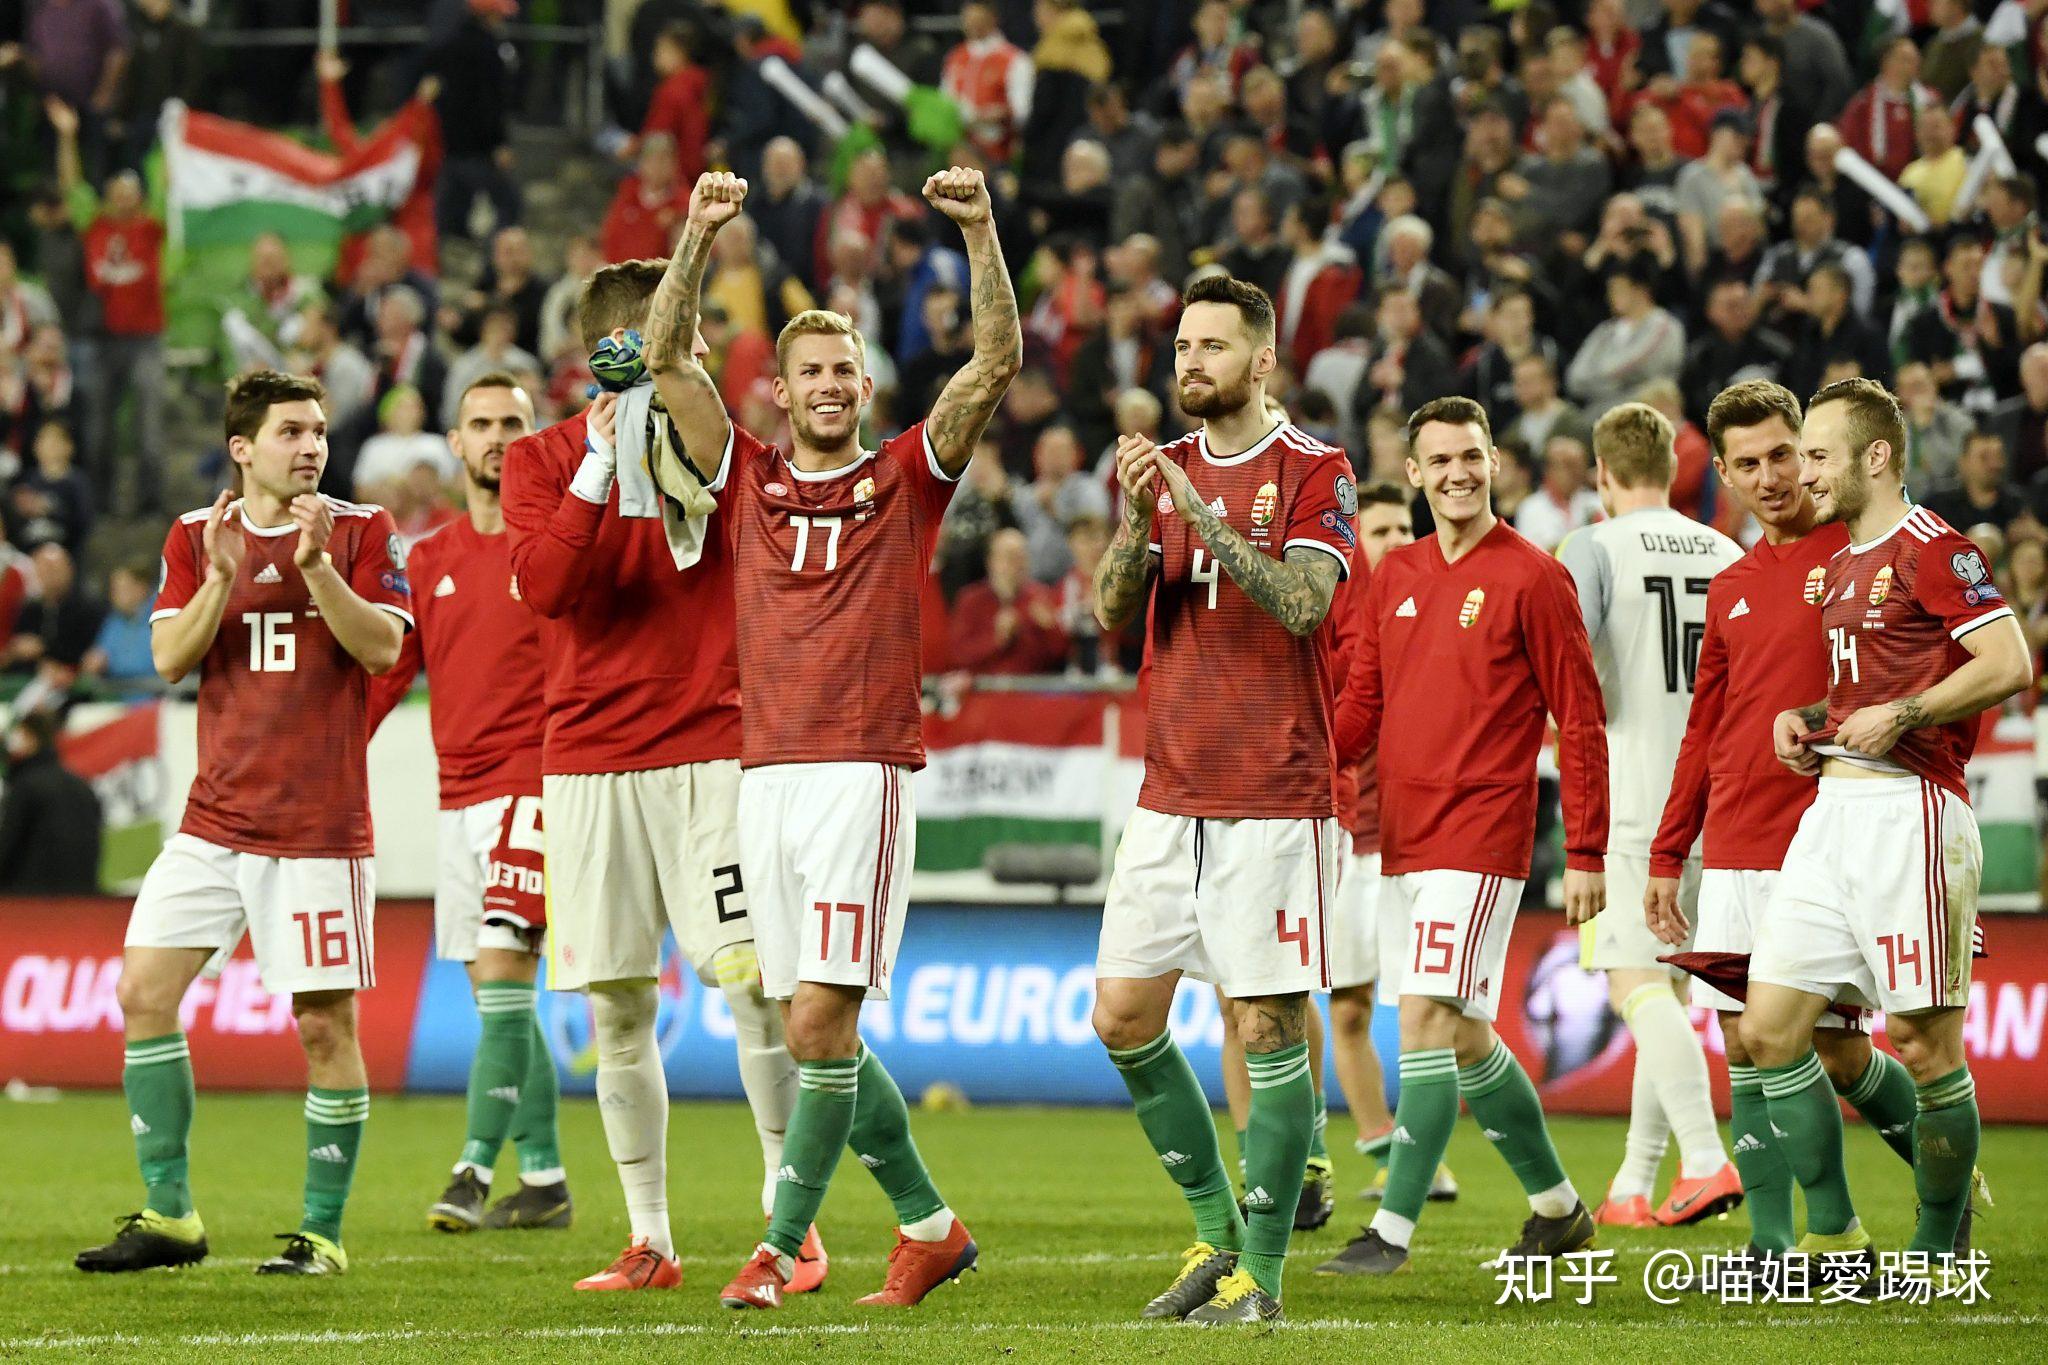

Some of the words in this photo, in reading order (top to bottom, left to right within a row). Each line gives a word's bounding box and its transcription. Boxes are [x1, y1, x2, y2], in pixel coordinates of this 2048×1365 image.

[789, 515, 842, 572] 17
[1640, 532, 1719, 555] DIBUSZ
[1191, 548, 1220, 610] 4
[242, 612, 297, 673] 16
[1828, 627, 1859, 686] 14
[293, 910, 350, 967] 16
[814, 902, 865, 963] 17
[1276, 909, 1310, 967] 4
[1414, 920, 1456, 974] 15
[1876, 933, 1922, 992] 14
[903, 963, 1099, 1045] EURO
